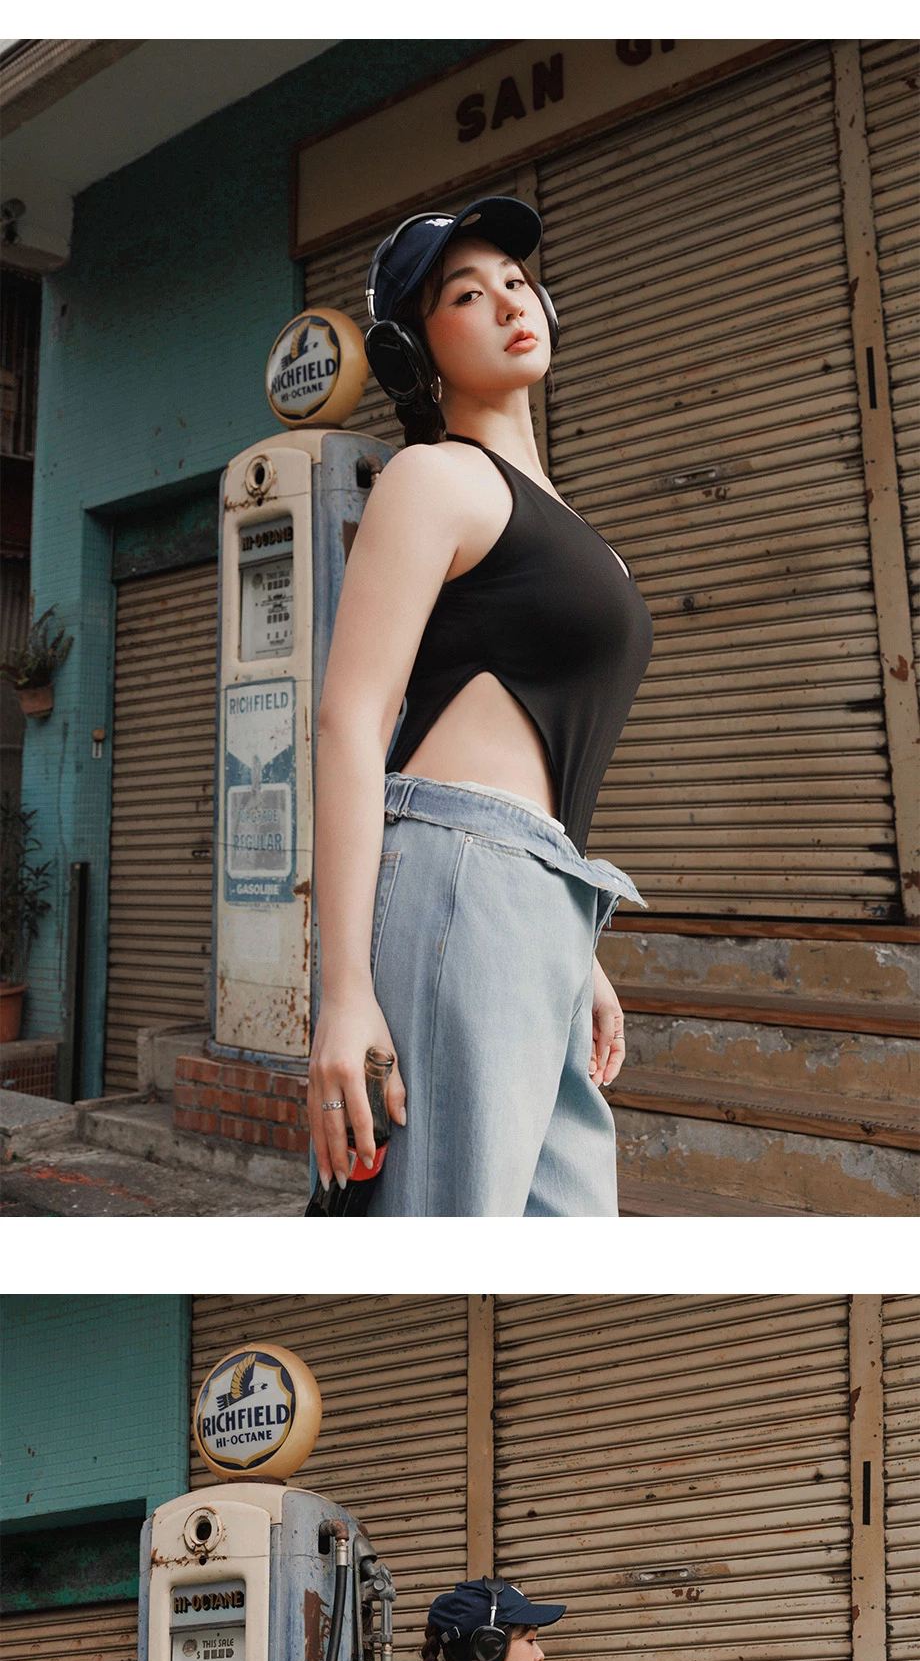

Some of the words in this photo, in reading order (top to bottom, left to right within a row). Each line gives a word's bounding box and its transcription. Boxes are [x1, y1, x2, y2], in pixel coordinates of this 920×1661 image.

[456, 52, 564, 144] SAN
[271, 358, 337, 396] RICHFIELD
[280, 382, 324, 403] HI-OCTANE
[229, 691, 289, 715] RICHFIELD
[233, 833, 282, 851] REGULAR
[236, 884, 280, 896] GASOLINE
[202, 1403, 290, 1438] RICHFIELD
[215, 1429, 273, 1449] HI-OCTANE
[173, 1589, 245, 1615] HI-OCTANE
[202, 1639, 218, 1649] THIS
[218, 1638, 235, 1648] SALE
